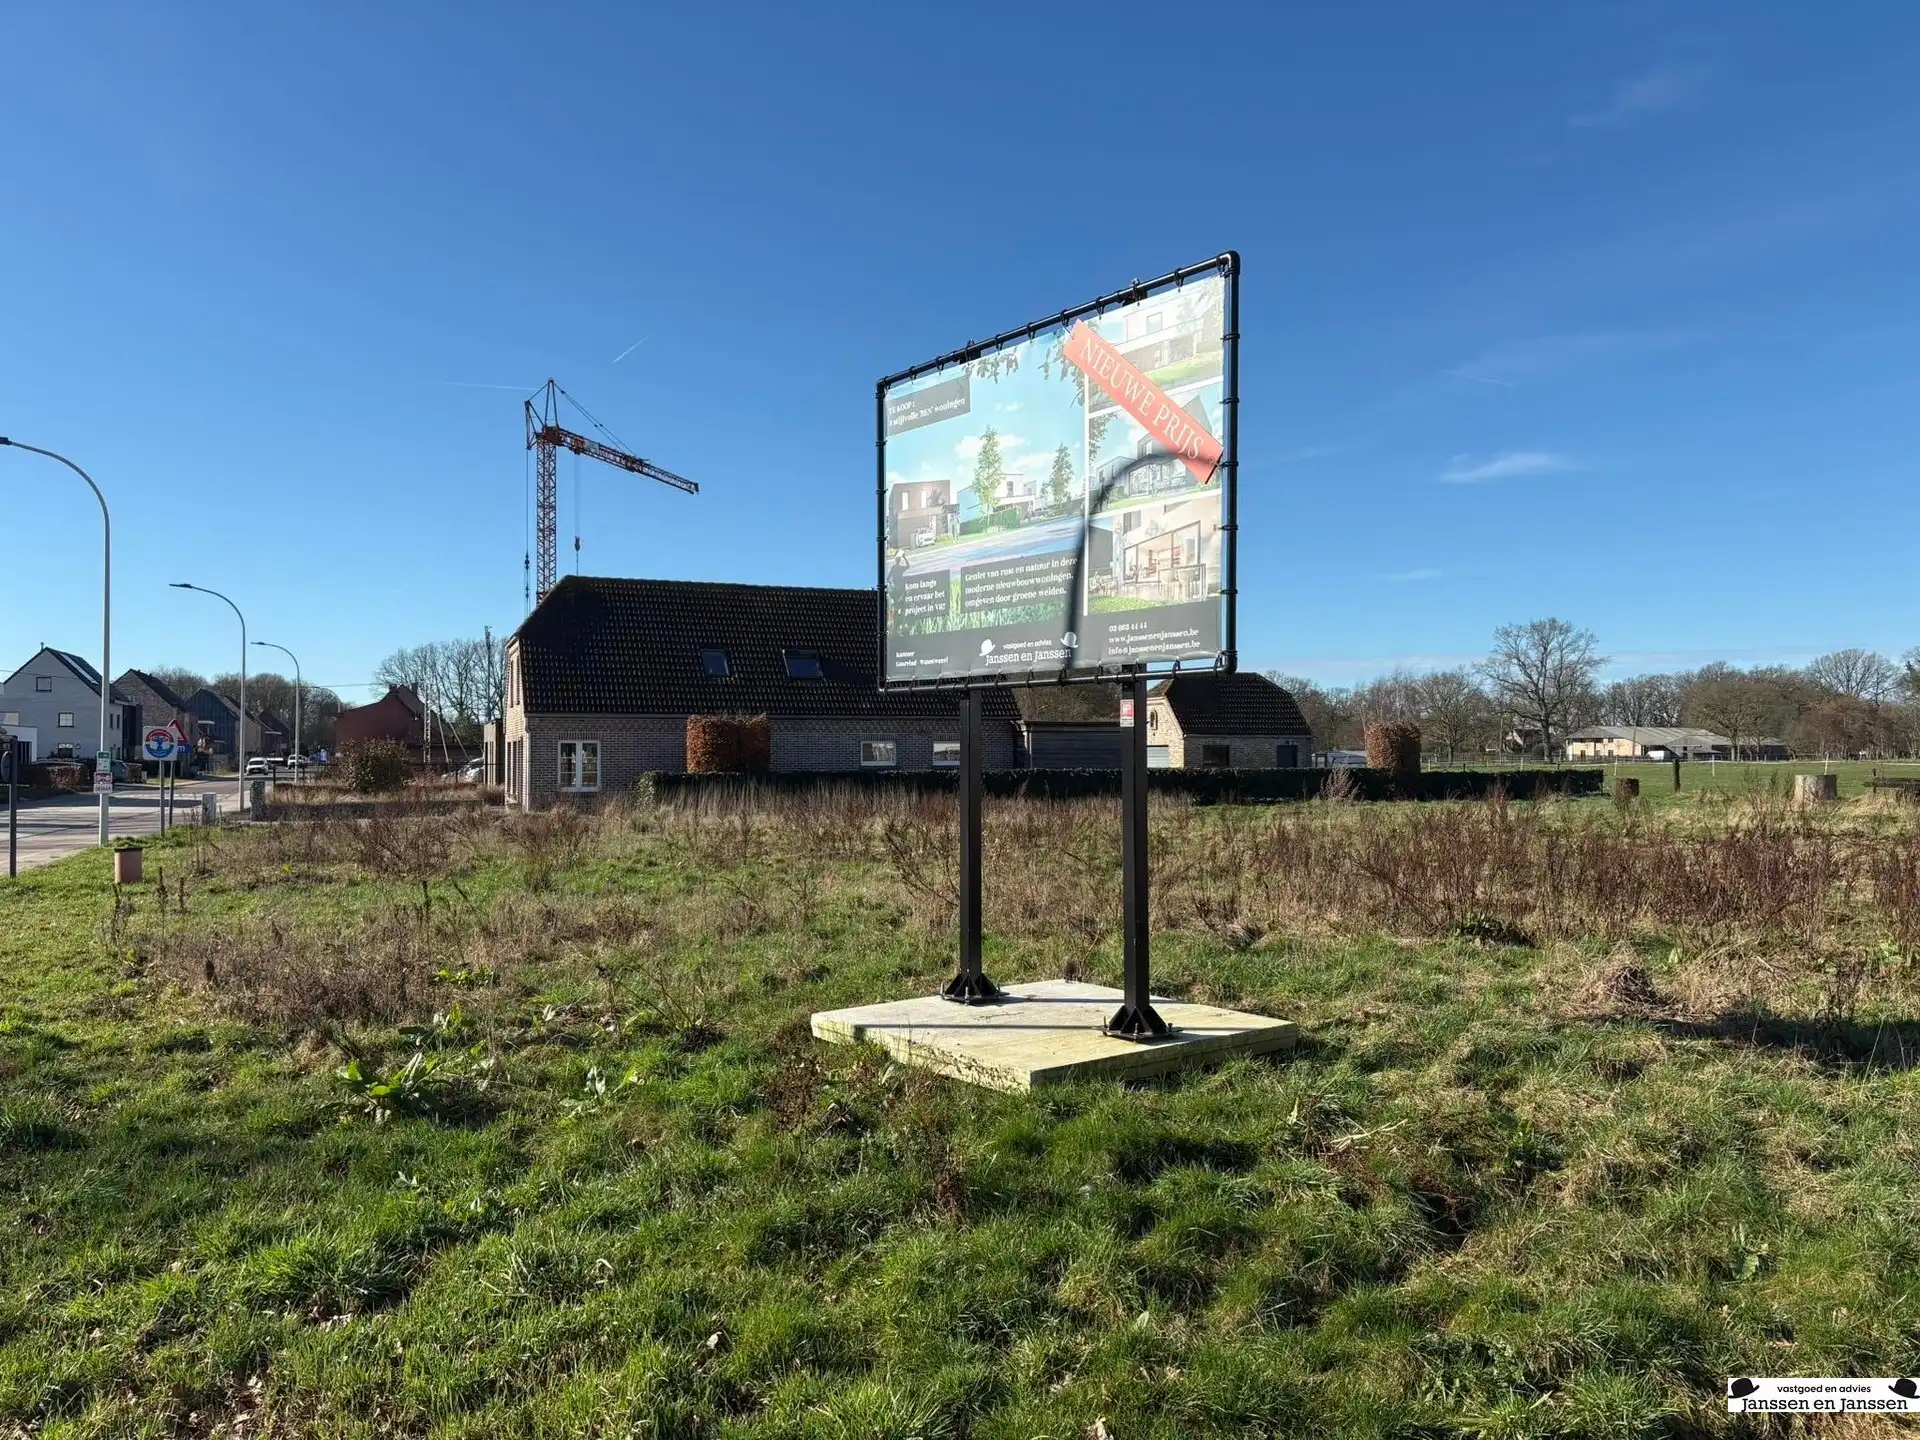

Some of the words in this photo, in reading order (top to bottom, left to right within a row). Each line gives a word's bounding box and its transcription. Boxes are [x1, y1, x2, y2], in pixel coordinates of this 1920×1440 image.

[1079, 338, 1156, 416] NIEUWE
[1152, 403, 1204, 459] PRIJS
[965, 571, 986, 582] Geniet
[987, 570, 999, 578] van
[1000, 566, 1014, 576] rust
[1015, 565, 1025, 574] en
[1025, 561, 1050, 573] natuur
[1051, 559, 1059, 568] in
[1060, 557, 1078, 567] deze
[913, 592, 934, 602] ervaar
[965, 583, 995, 595] moderne
[964, 596, 994, 608] omgeven
[995, 593, 1012, 603] door
[1012, 591, 1037, 603] groene
[905, 604, 927, 616] project
[927, 603, 934, 611] in
[985, 652, 1019, 666] Janssen
[1020, 651, 1032, 662] en
[1033, 648, 1072, 663] Janssen
